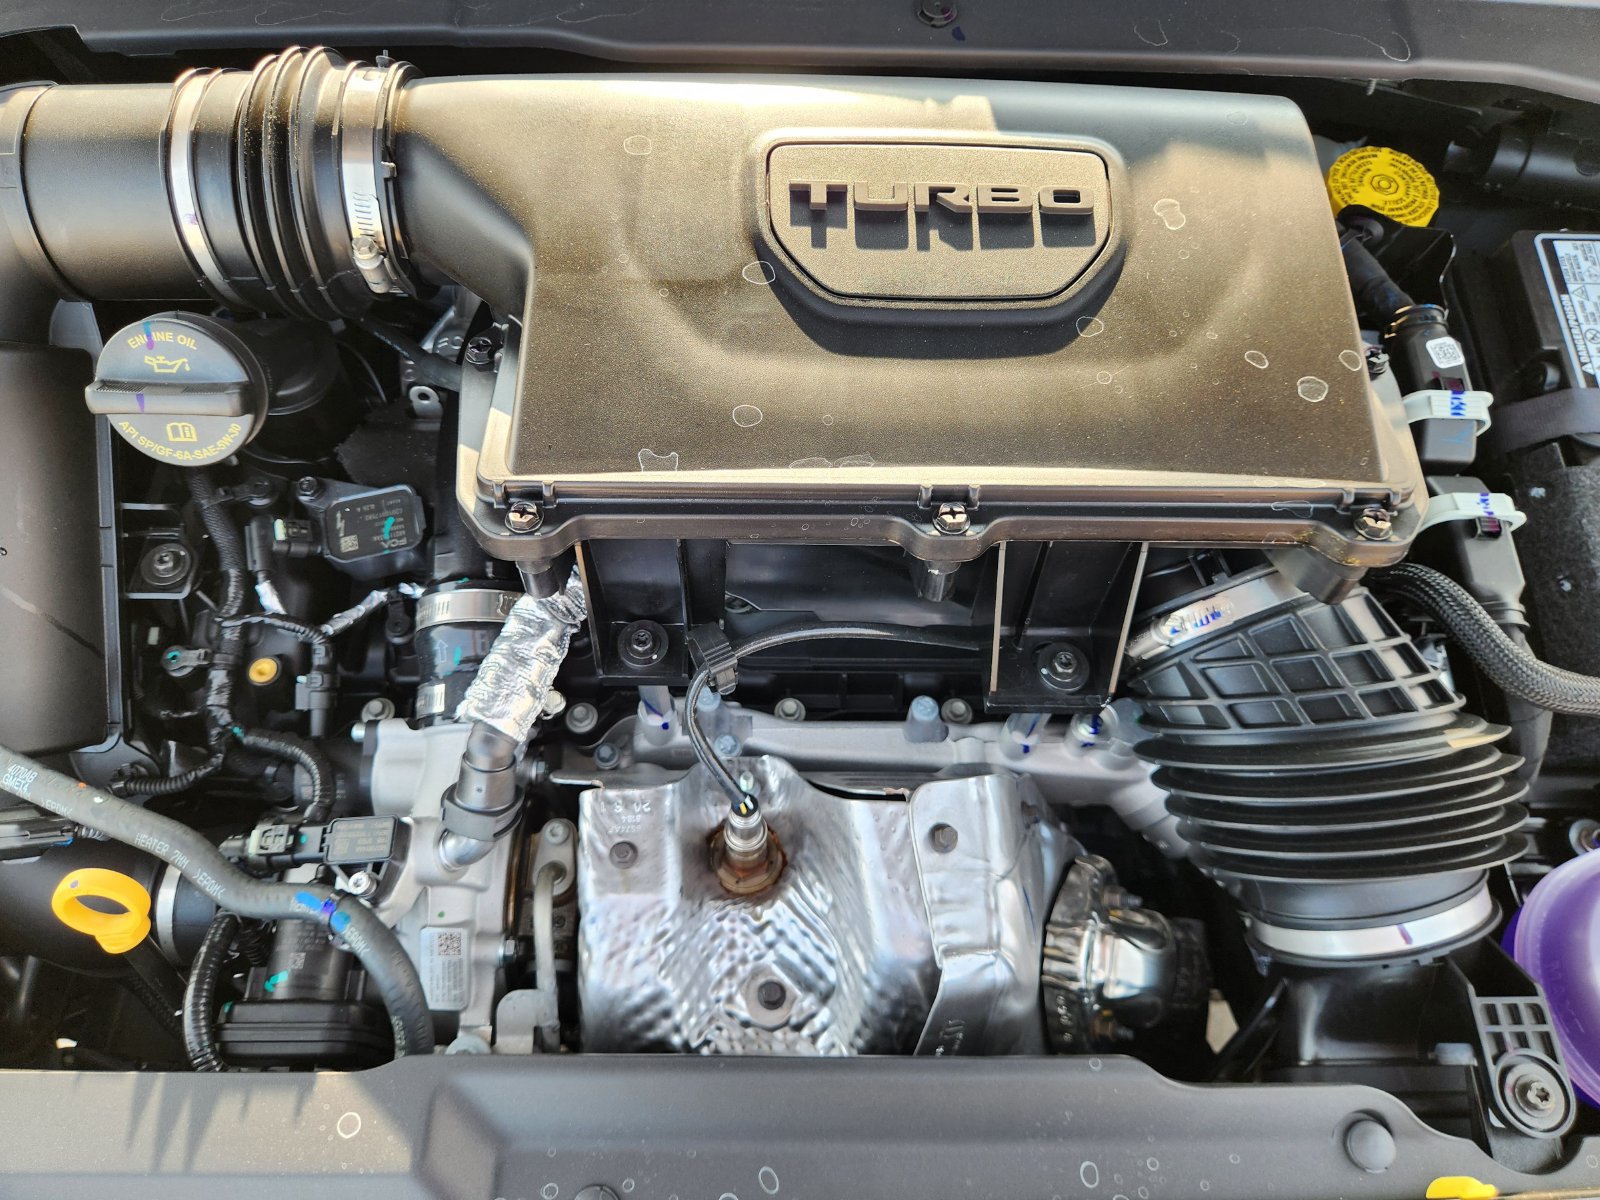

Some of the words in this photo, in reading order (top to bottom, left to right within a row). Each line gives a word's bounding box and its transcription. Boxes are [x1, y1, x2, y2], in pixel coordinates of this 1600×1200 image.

[789, 180, 1094, 215] TURBO
[127, 331, 174, 350] ENINE
[177, 334, 198, 350] OIL
[119, 420, 139, 440] API
[134, 833, 169, 856] HEATER
